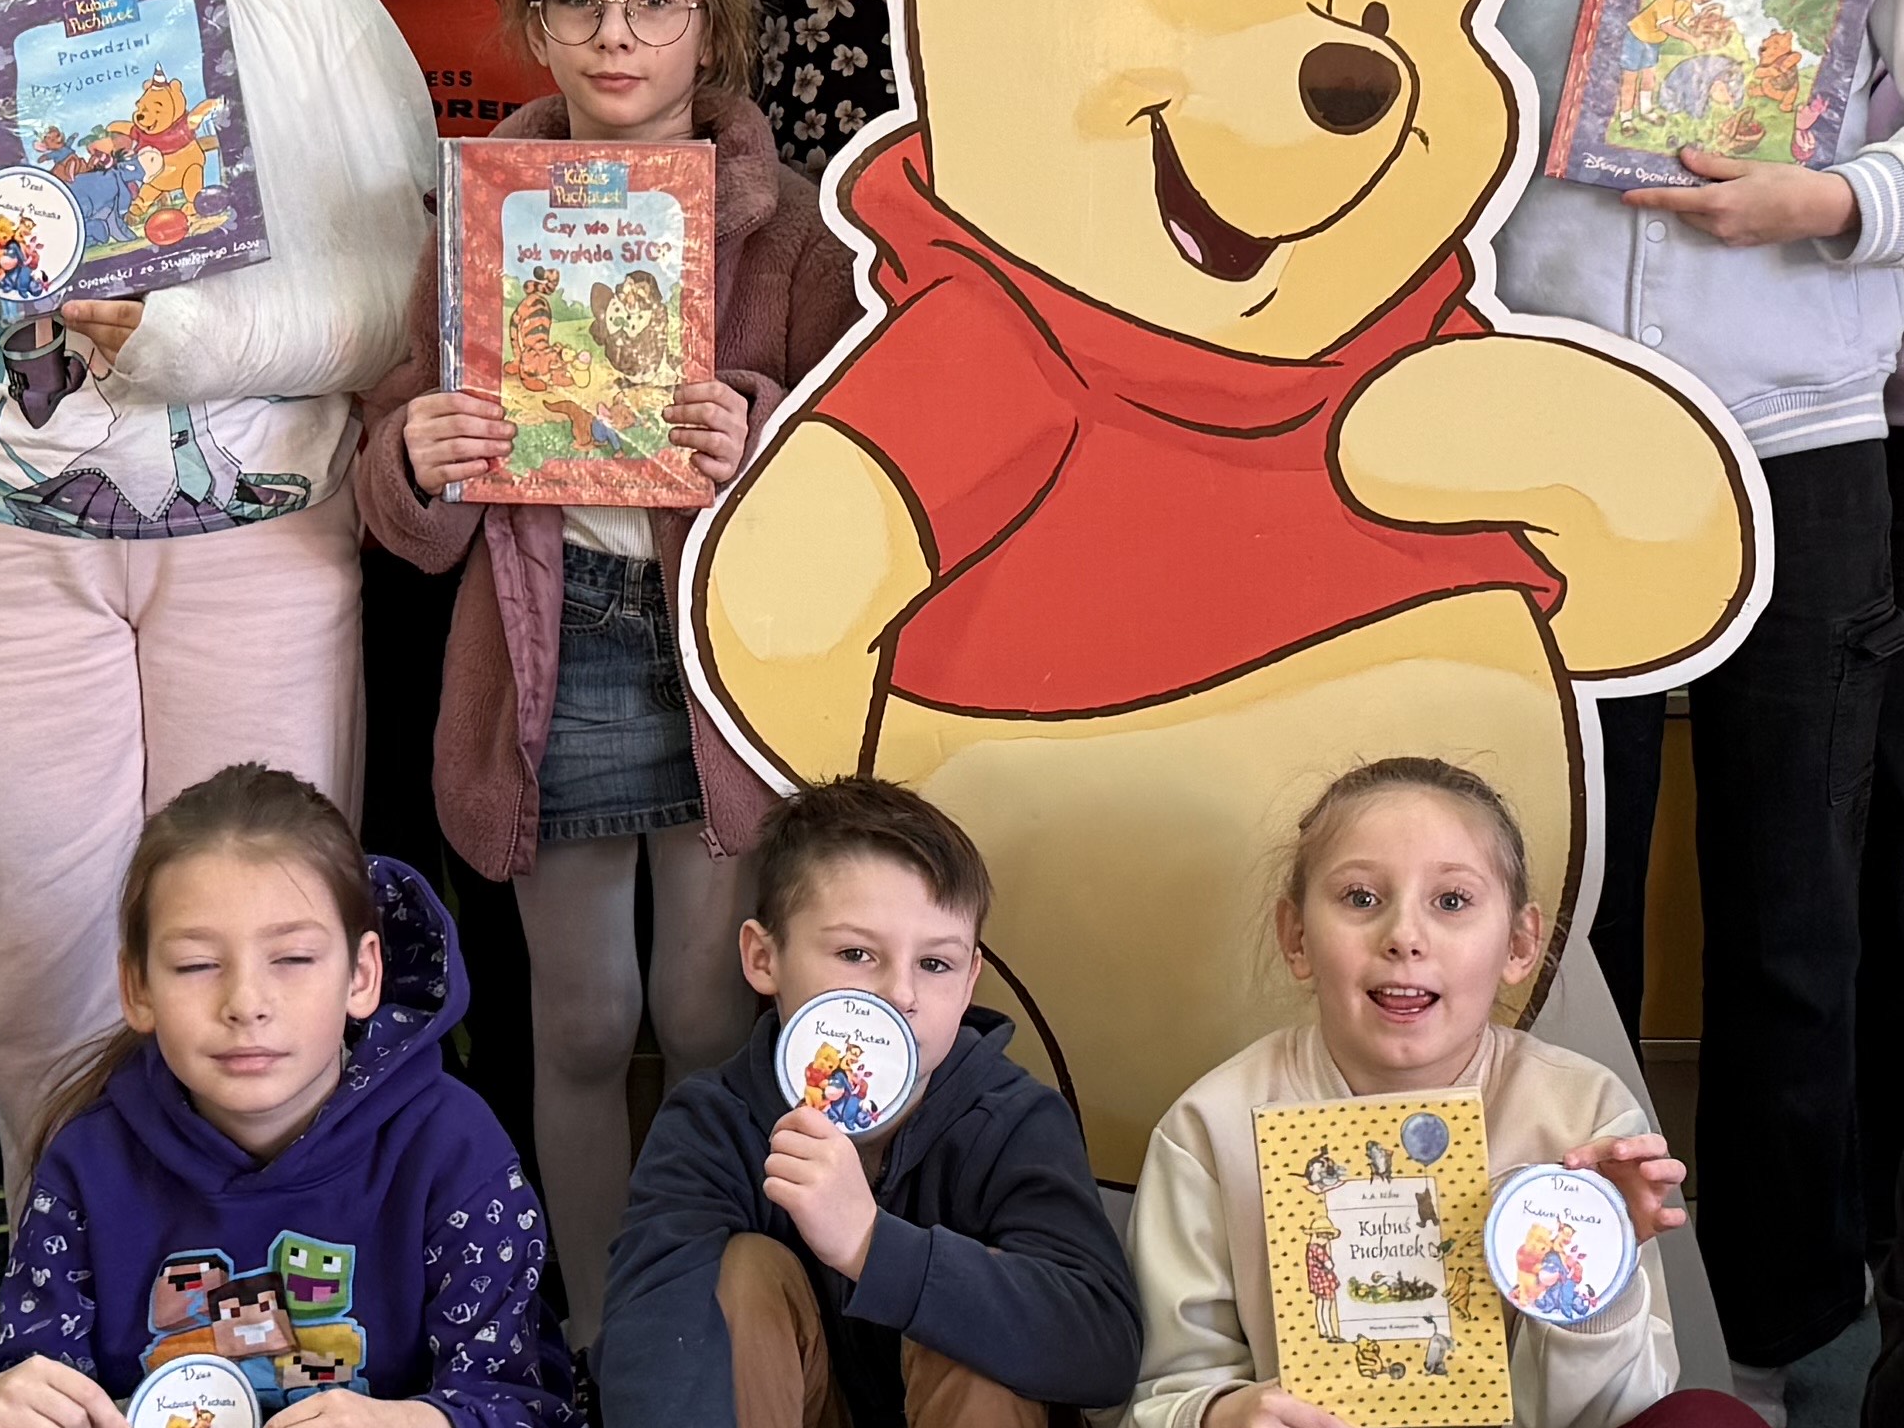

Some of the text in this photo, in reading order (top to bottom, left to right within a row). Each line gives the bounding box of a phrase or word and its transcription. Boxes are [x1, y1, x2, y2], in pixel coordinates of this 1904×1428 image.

[58, 34, 150, 66] Prawdziwi
[543, 212, 576, 238] Czy
[233, 240, 260, 253] Lasu
[517, 243, 542, 263] jak
[550, 244, 614, 264] wygląda
[1358, 1212, 1411, 1237] Kubuś
[1350, 1234, 1425, 1260] Puchatek
